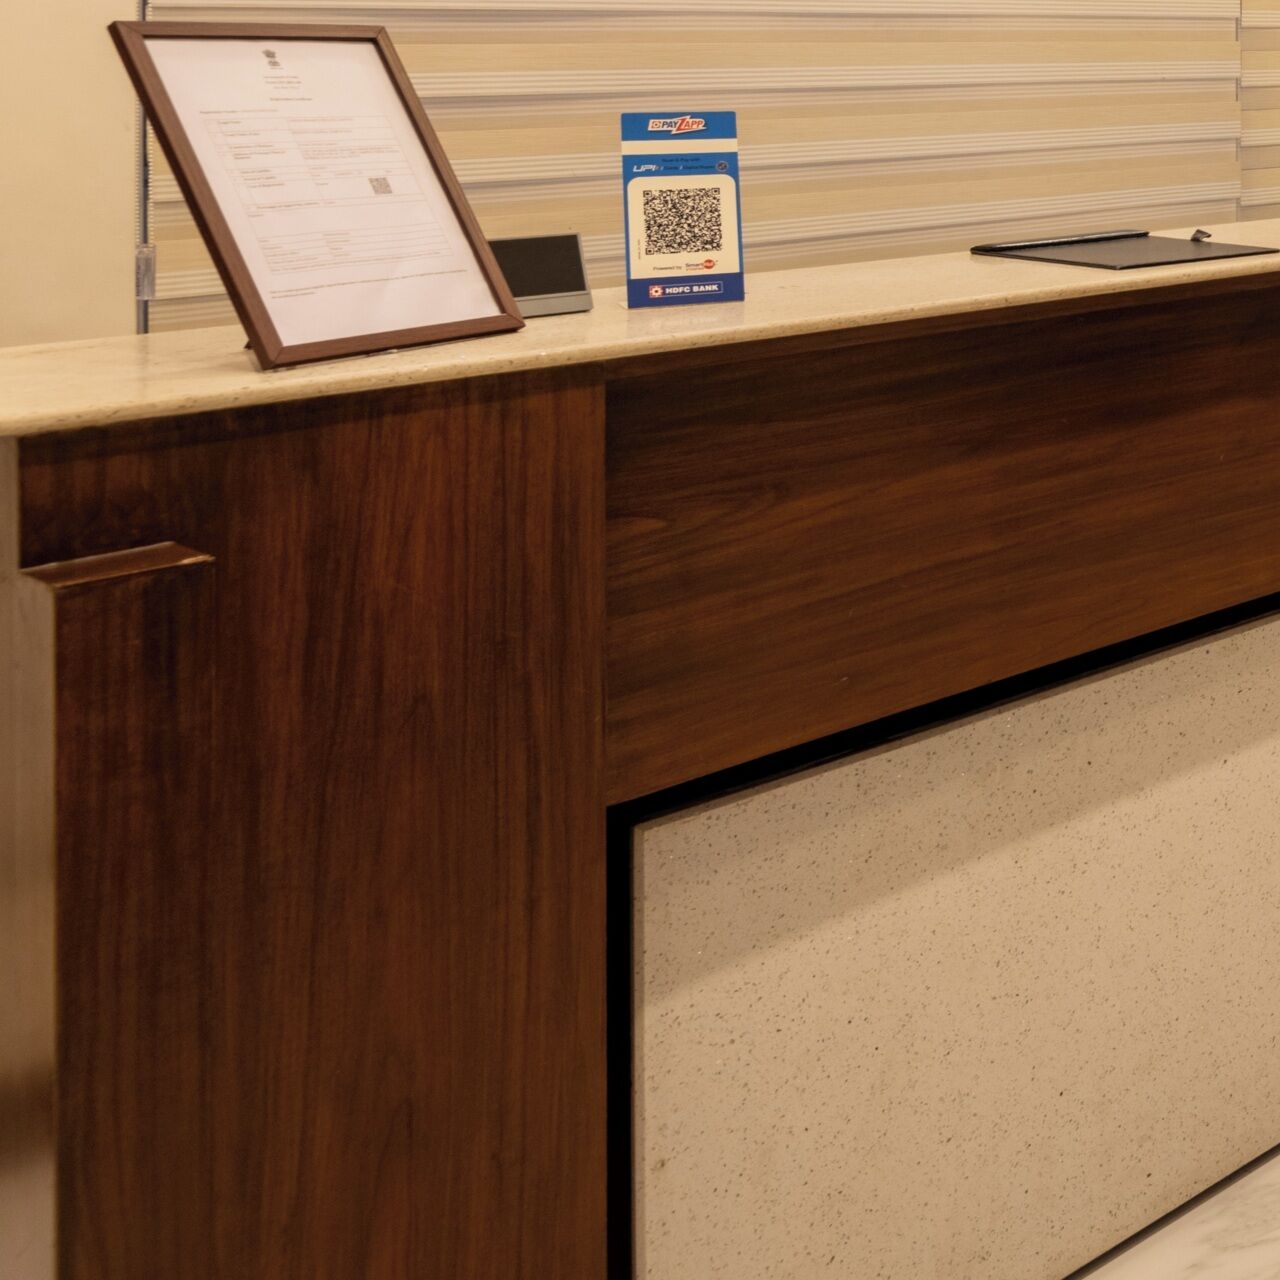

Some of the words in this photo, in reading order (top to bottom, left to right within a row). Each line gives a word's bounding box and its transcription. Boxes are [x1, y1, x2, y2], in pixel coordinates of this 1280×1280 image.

[661, 117, 704, 132] PAYZAPP
[633, 164, 657, 172] UPI
[665, 286, 691, 294] HDFC
[692, 284, 719, 293] BANK
